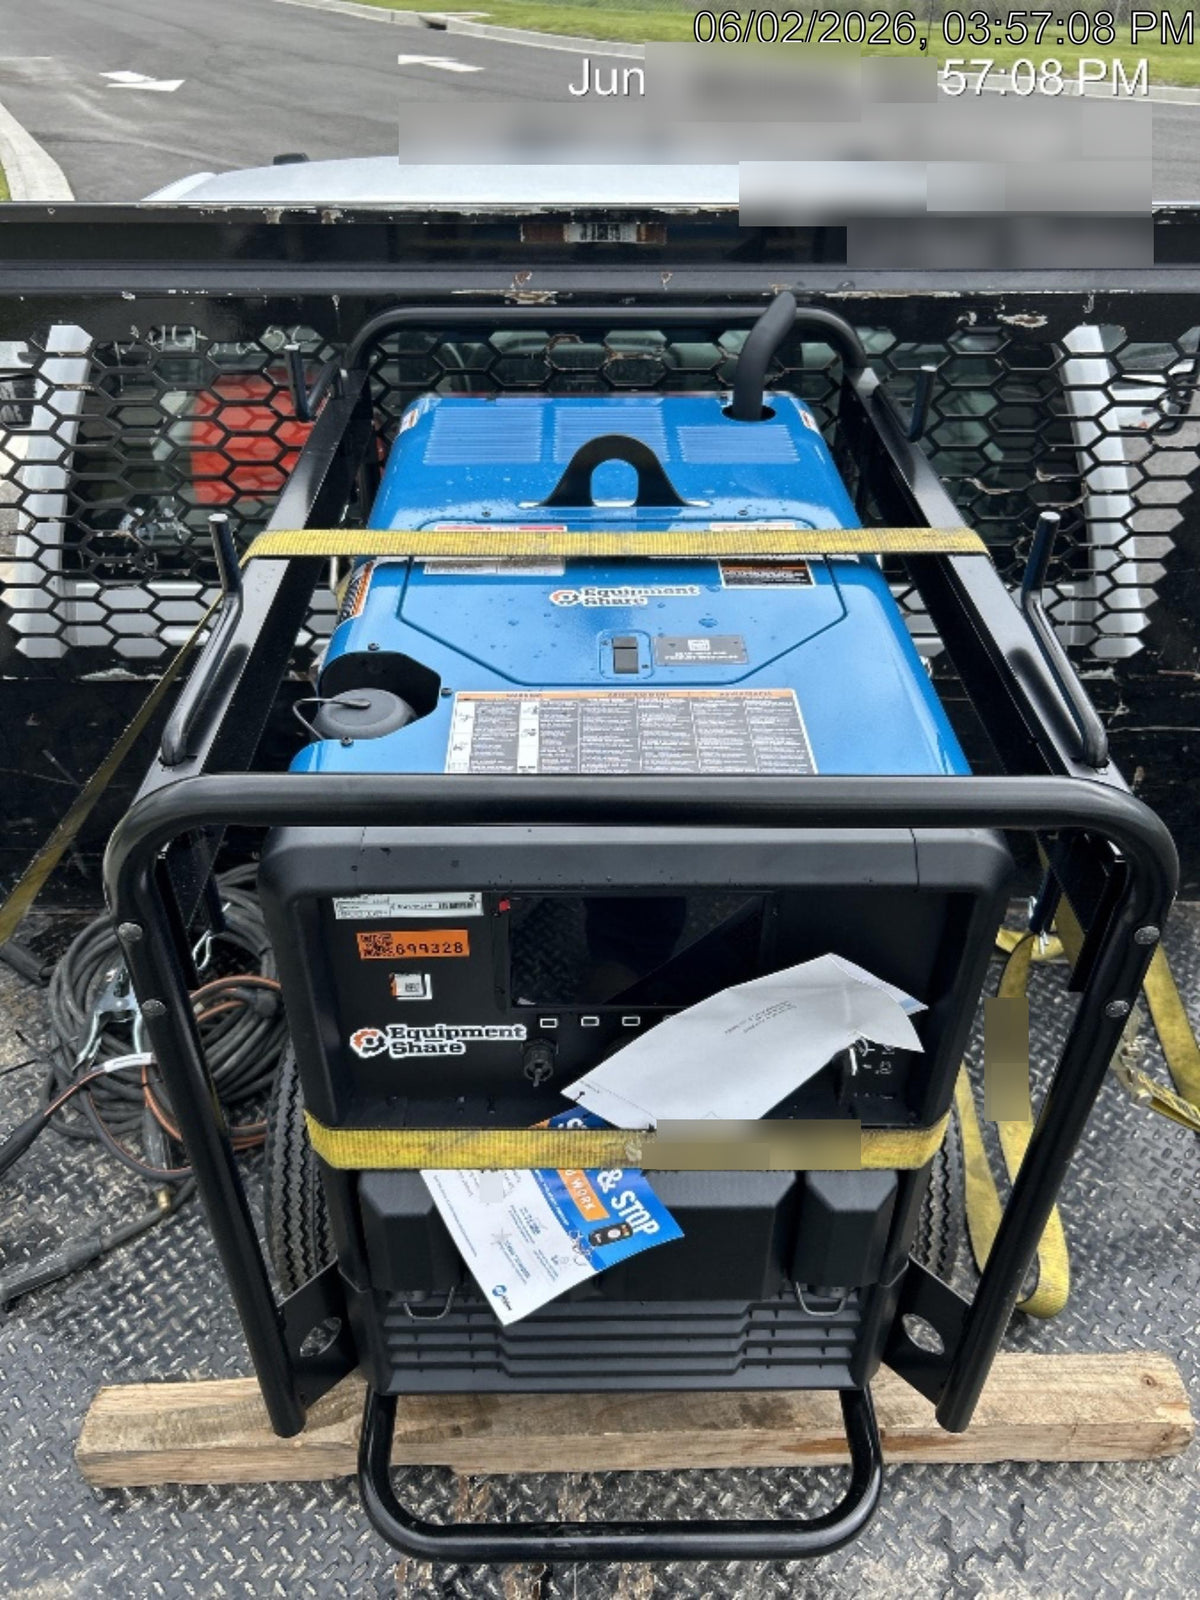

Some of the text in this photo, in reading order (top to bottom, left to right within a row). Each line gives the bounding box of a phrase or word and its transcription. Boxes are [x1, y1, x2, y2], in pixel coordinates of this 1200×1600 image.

[583, 586, 698, 597] Equipment
[584, 597, 645, 606] Share
[395, 942, 464, 955] 699328
[390, 1025, 525, 1041] Equipment
[391, 1041, 463, 1055] Share
[571, 1178, 597, 1210] WORK
[597, 1169, 660, 1234] & STOP
